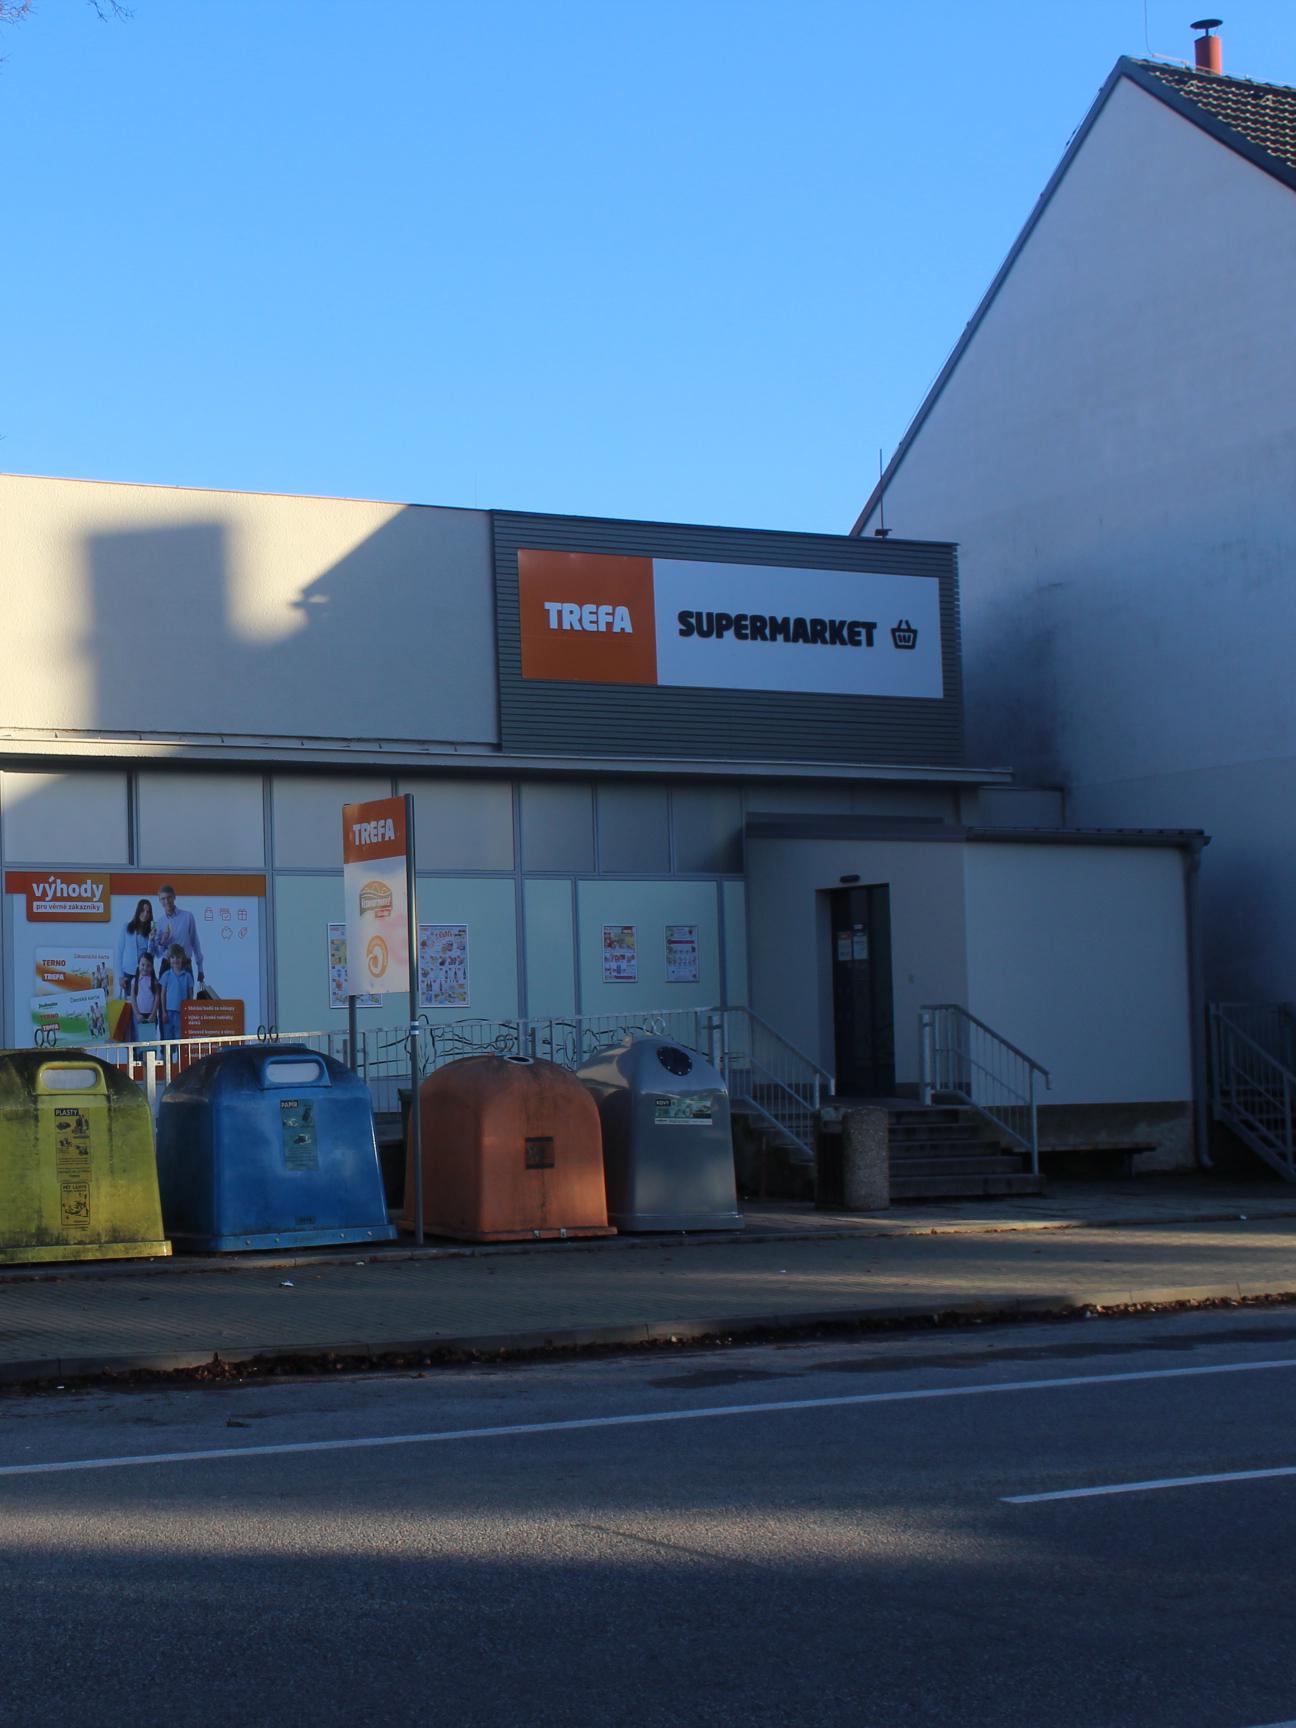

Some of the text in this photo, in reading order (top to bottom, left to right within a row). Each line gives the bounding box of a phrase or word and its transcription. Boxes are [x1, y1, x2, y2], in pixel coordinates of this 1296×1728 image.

[544, 601, 877, 647] TREFA SUPERMARKET
[352, 818, 395, 846] TREFA
[32, 876, 104, 902] výhody
[42, 959, 66, 967] TERNO
